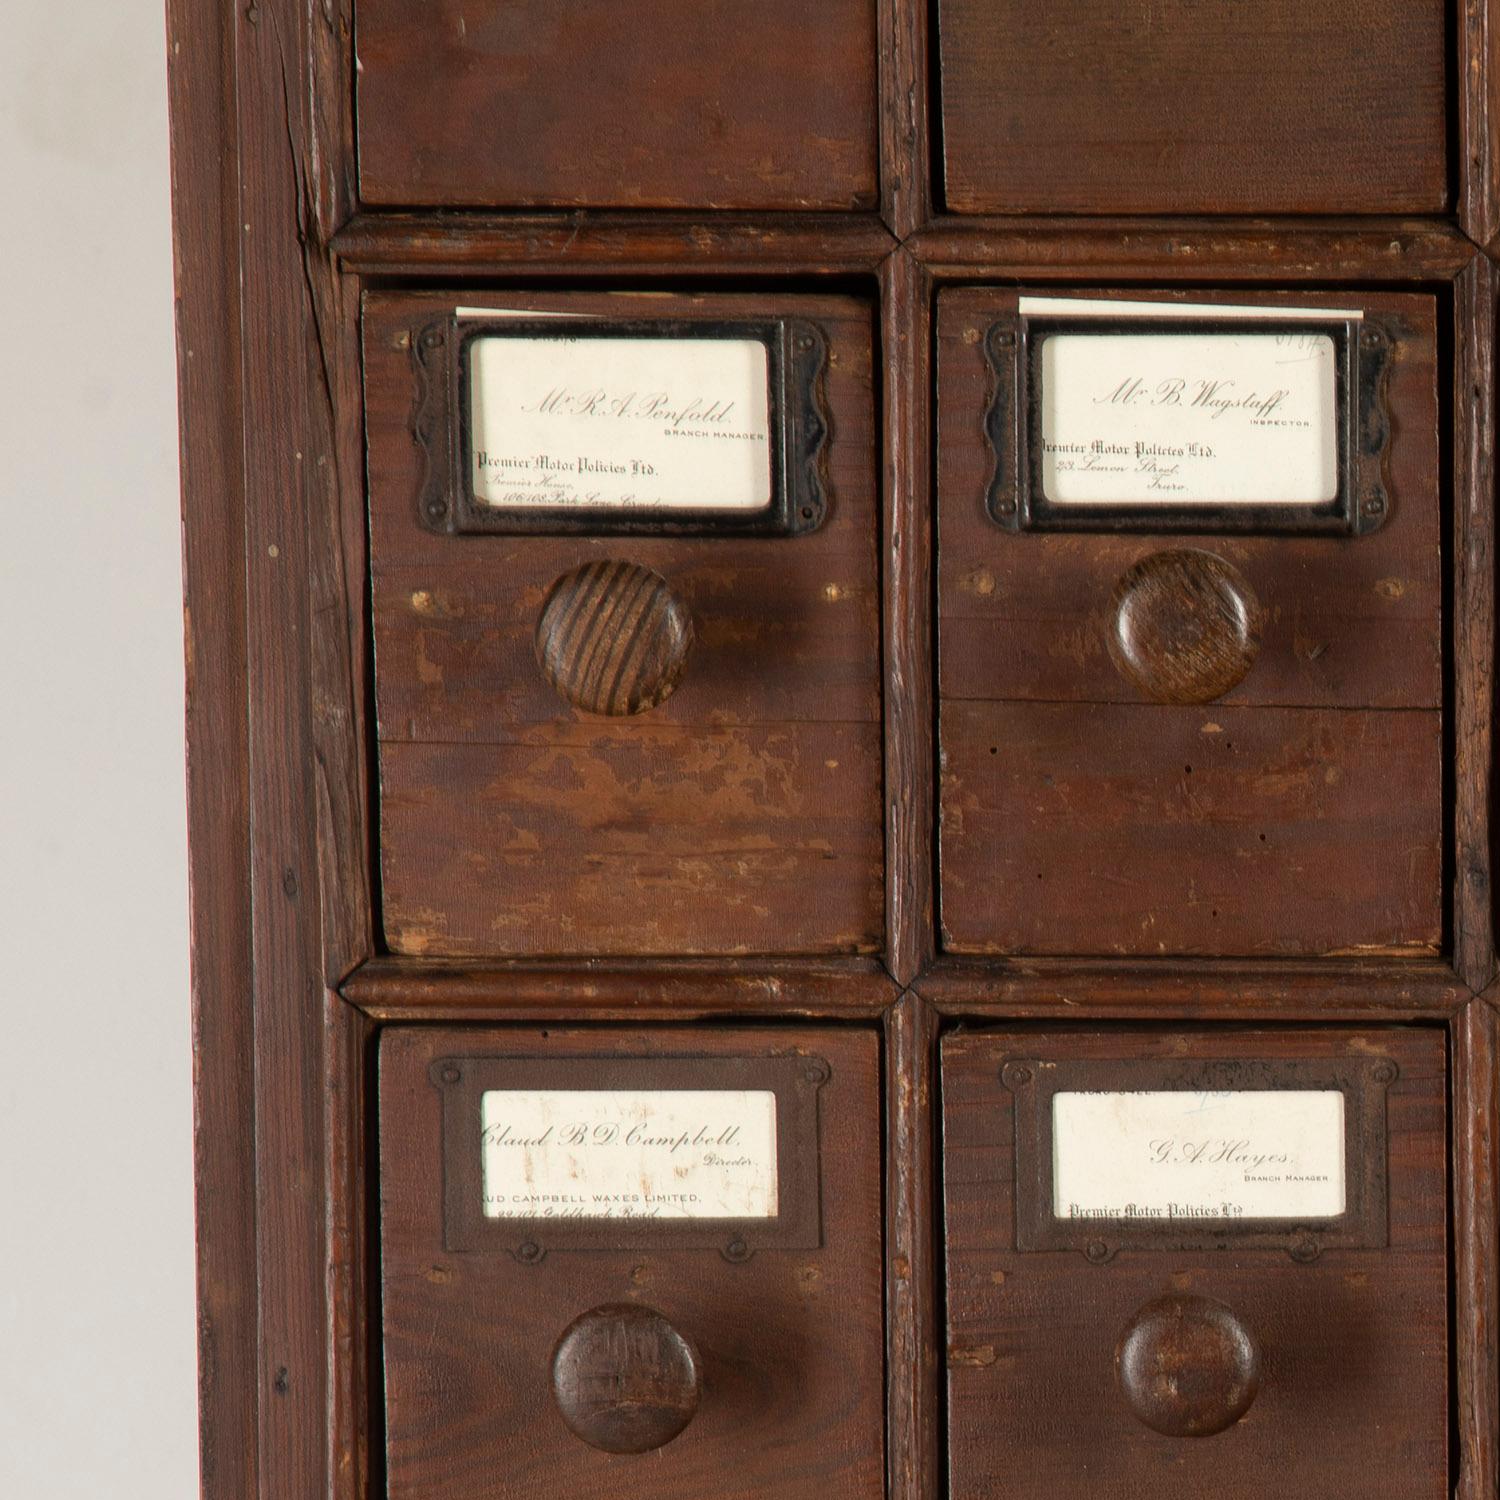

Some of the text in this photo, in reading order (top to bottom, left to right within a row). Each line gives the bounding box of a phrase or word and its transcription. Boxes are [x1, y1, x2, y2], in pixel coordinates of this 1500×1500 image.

[664, 429, 709, 438] BRANCH
[1091, 440, 1129, 455] Motor
[1135, 442, 1184, 458] Policies
[535, 455, 574, 471] Motor
[578, 457, 626, 474] Policies
[512, 1194, 639, 1203] CAMPBELL WAXES
[1070, 1203, 1120, 1218] Premier
[1125, 1203, 1162, 1217] Motor
[1168, 1203, 1218, 1218] Policies
